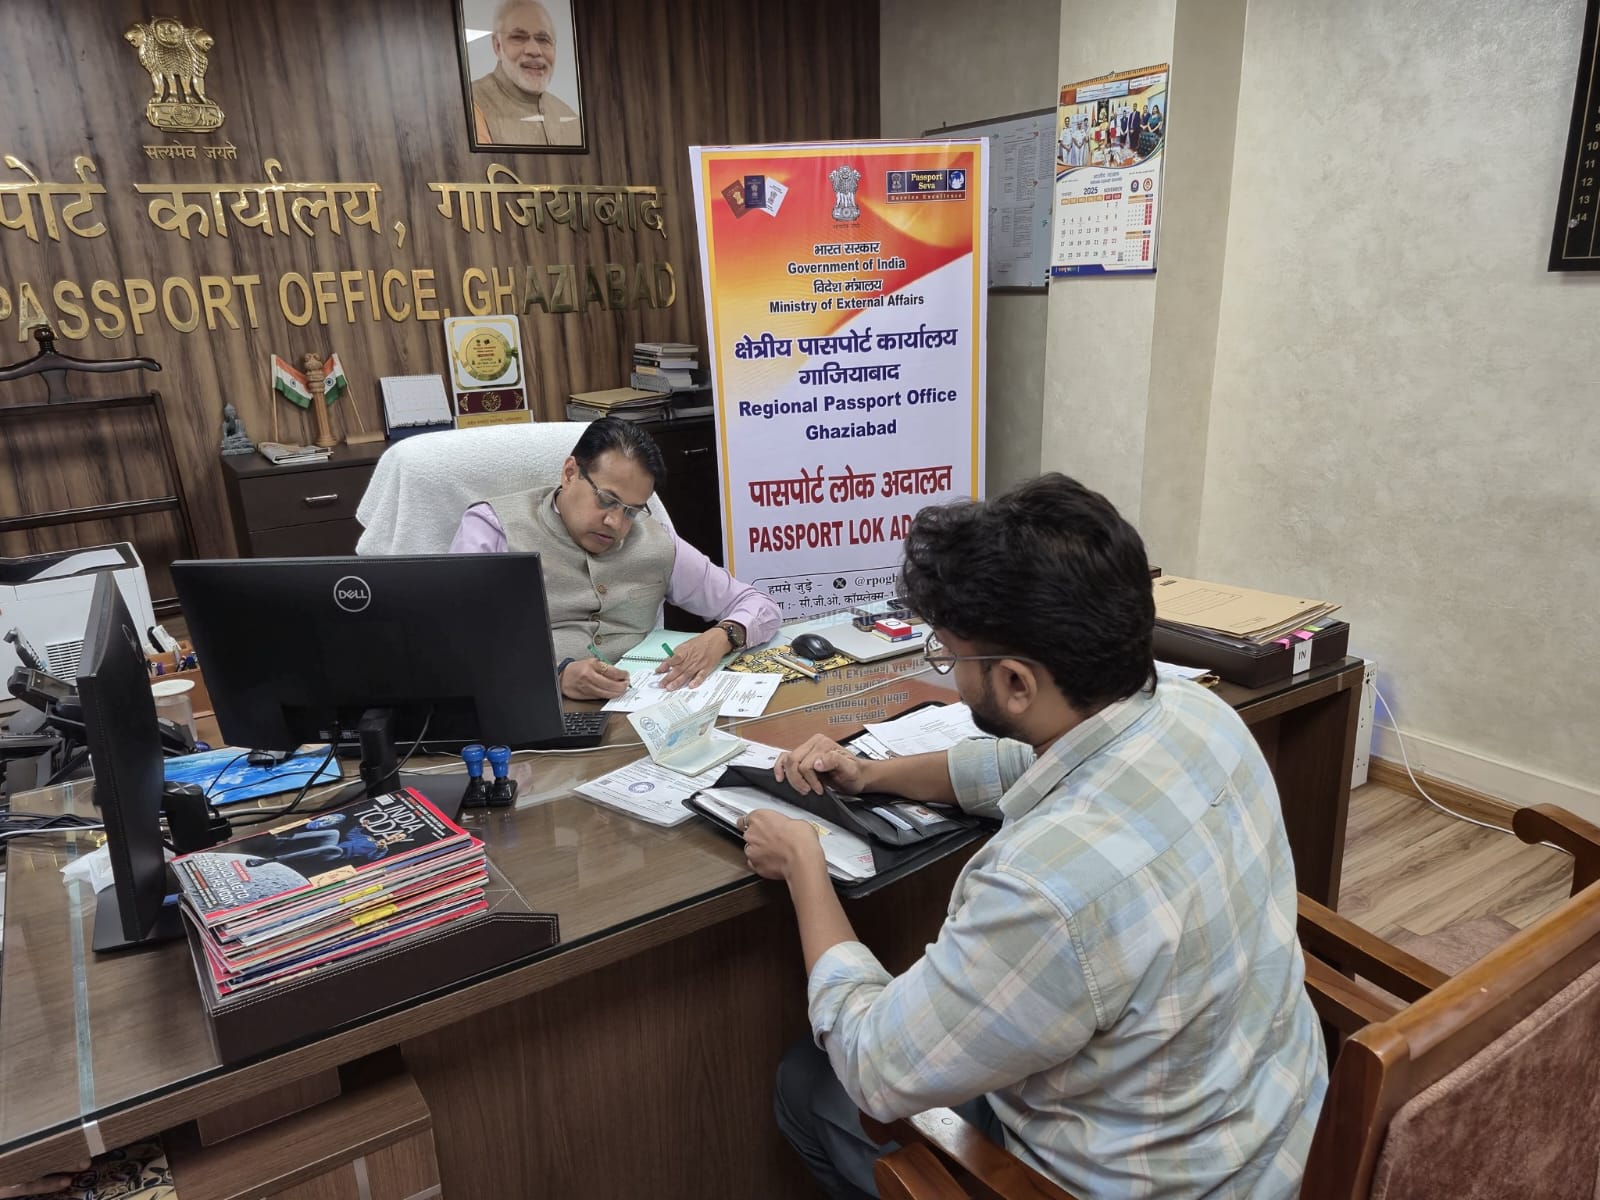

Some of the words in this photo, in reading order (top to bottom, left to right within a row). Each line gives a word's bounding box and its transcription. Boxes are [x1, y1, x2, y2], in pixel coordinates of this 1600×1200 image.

[143, 140, 196, 160] सत्यमेव
[203, 140, 238, 160] जयते
[1588, 142, 1598, 150] 10
[1584, 160, 1595, 168] 11
[911, 173, 942, 182] Passport
[1582, 178, 1592, 186] 12
[1084, 187, 1098, 195] 2025
[1579, 196, 1590, 204] 13
[1577, 213, 1587, 222] 14
[814, 244, 841, 256] भारत
[844, 242, 880, 254] सरकार
[788, 262, 859, 274] Government
[862, 259, 874, 270] of
[878, 258, 905, 270] India
[462, 262, 677, 316] GHAZIABAD
[814, 279, 842, 293] विदेश
[844, 278, 882, 292] मंत्रालय
[769, 298, 817, 314] Ministry
[821, 298, 832, 310] of
[836, 296, 884, 310] External
[887, 294, 925, 306] Affairs
[734, 333, 792, 360] क्षेत्रीय
[798, 328, 872, 356] पासपोर्ट
[876, 324, 958, 351] कार्यालय
[798, 362, 901, 386] गाजियाबाद
[739, 397, 818, 419] Regional
[824, 391, 902, 412] Passport
[906, 388, 958, 406] Office
[806, 420, 898, 440] Ghaziabad
[748, 465, 825, 508] पासपोर्ट
[828, 464, 876, 503] लोक
[880, 465, 952, 498] अदालत
[748, 520, 844, 553] PASSPORT
[849, 516, 885, 546] LOK
[338, 590, 368, 599] DELL
[768, 582, 790, 595] हमसे
[1298, 650, 1306, 660] IN
[384, 804, 425, 834] INDIA
